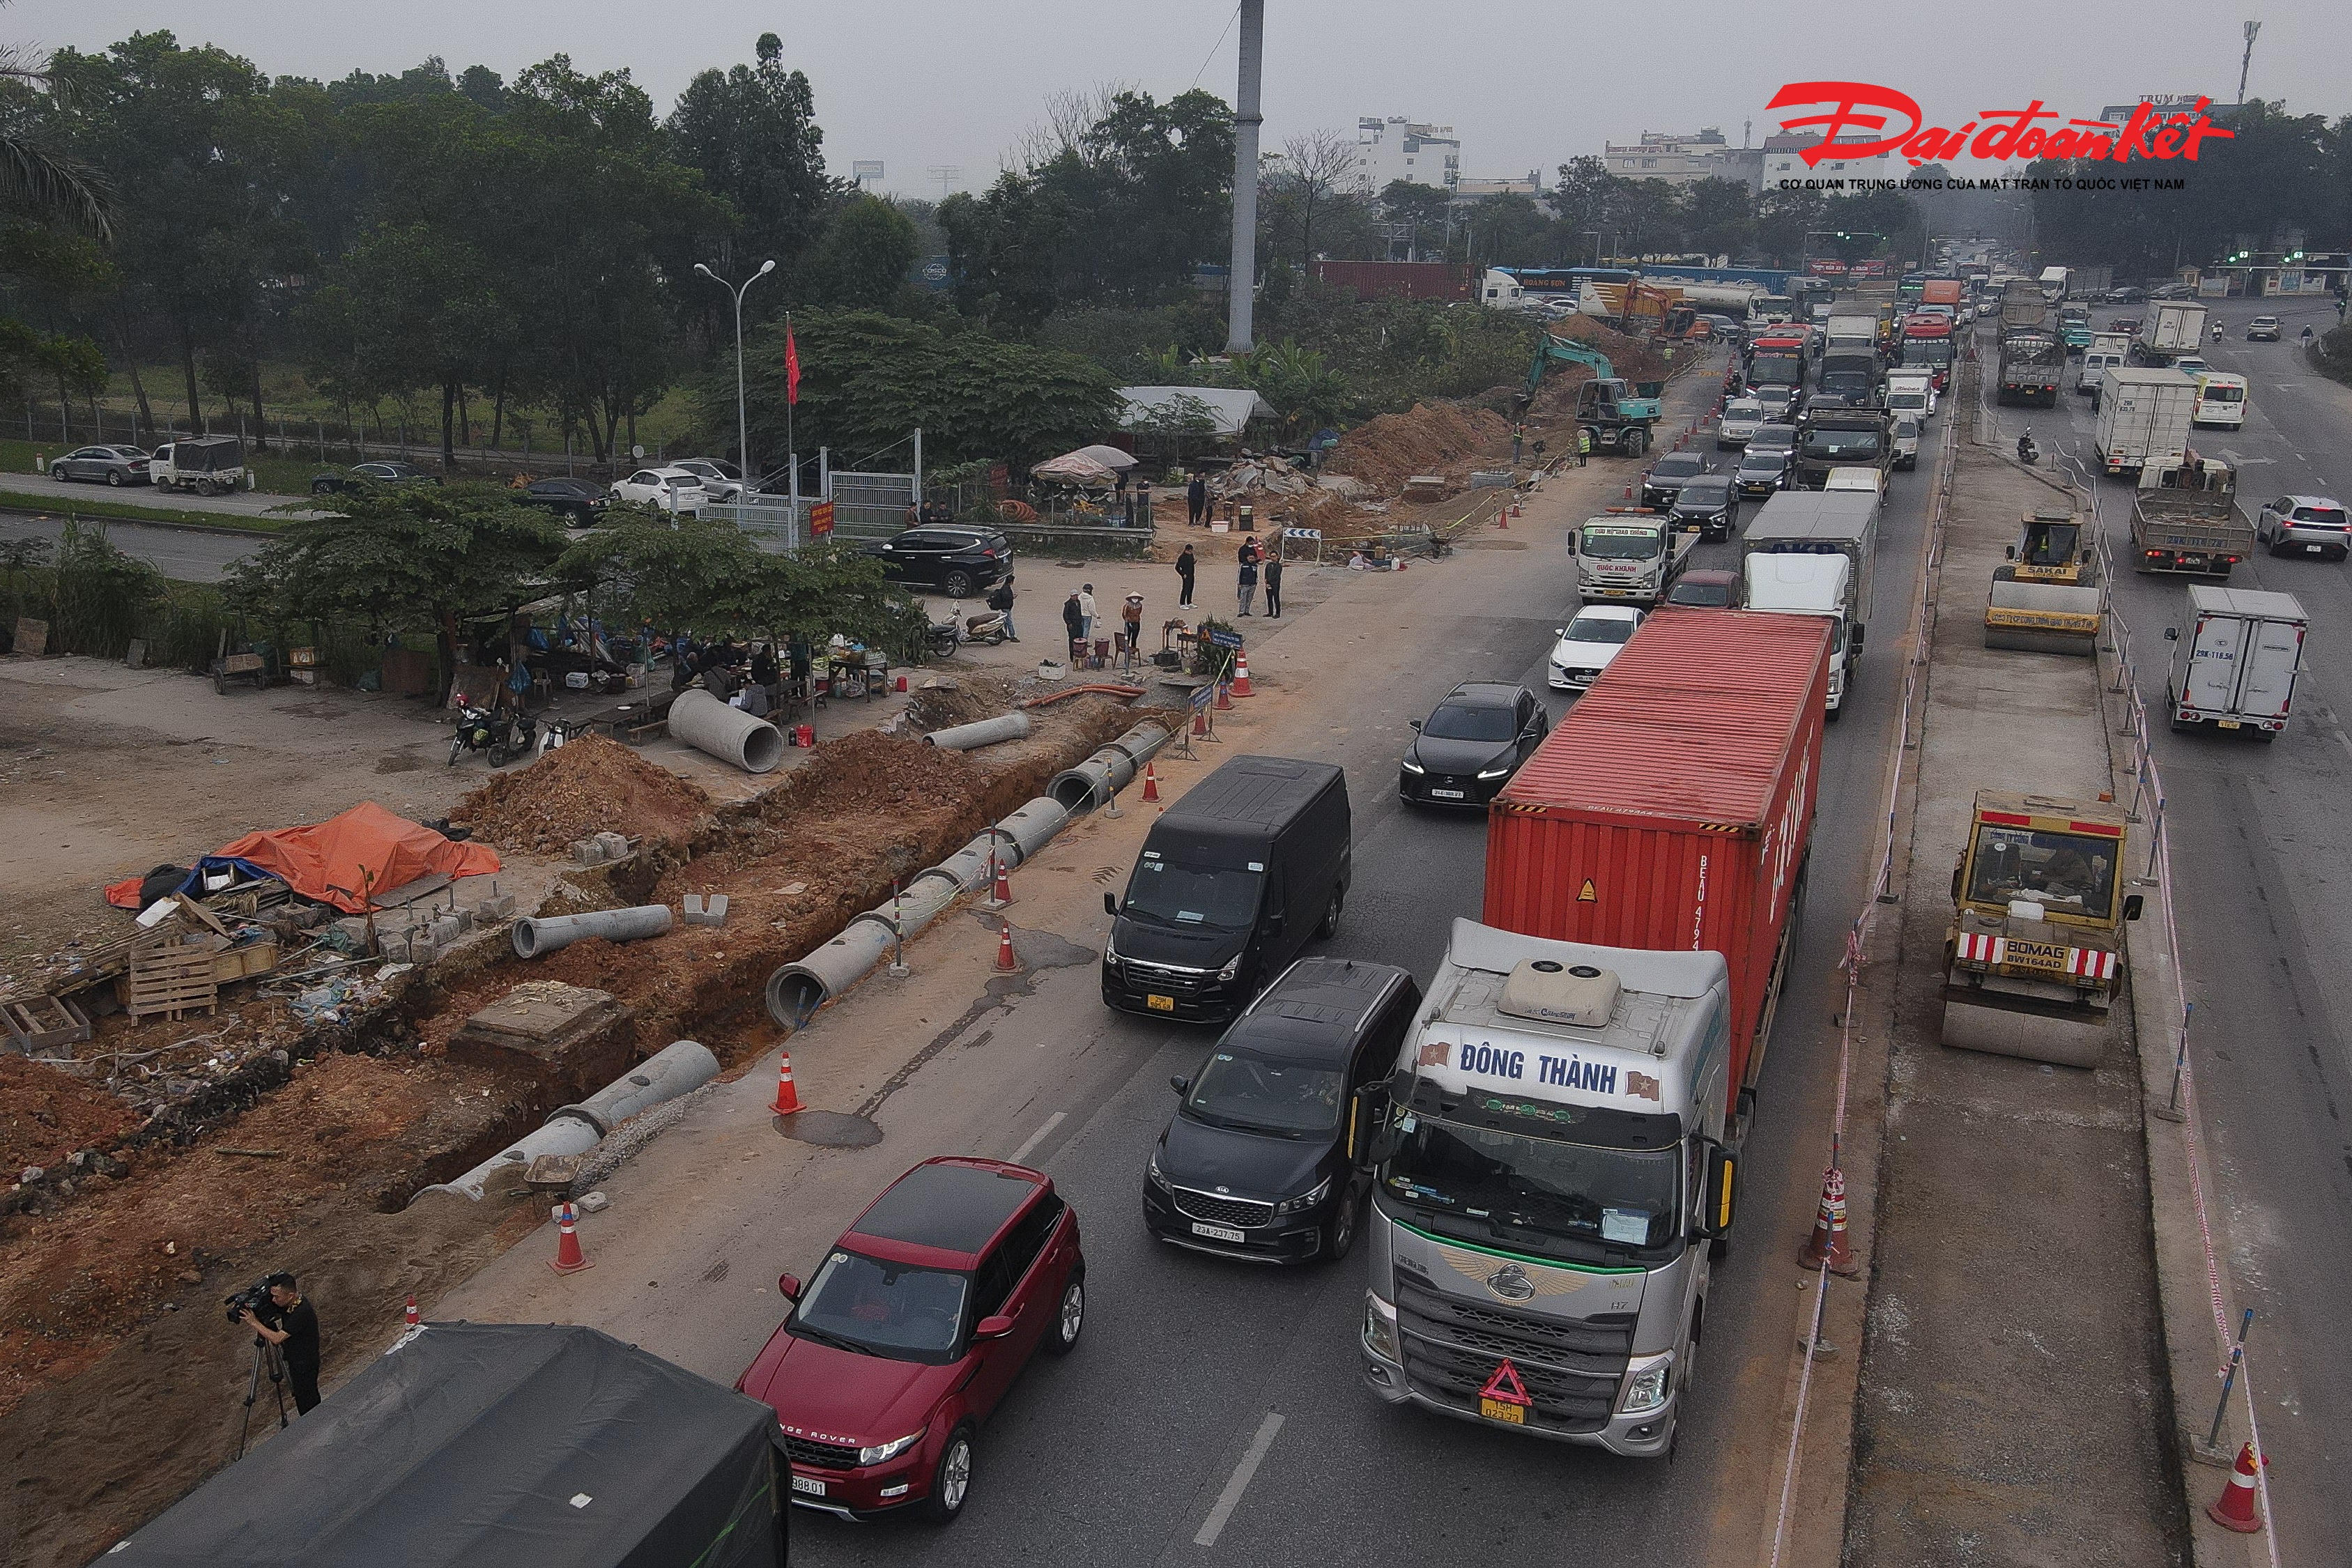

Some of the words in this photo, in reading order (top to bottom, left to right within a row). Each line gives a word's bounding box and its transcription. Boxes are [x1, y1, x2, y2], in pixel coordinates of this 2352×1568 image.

[2027, 566, 2067, 575] SAKAI
[1698, 854, 1707, 902] BEAU
[2007, 941, 2065, 959] BOMAG
[2007, 954, 2061, 969] BW164AD
[1460, 1041, 1525, 1079] ĐÔNG
[1539, 1053, 1617, 1094] THÀNH
[1611, 1301, 1629, 1310] H7
[811, 1431, 855, 1444] ROVER
